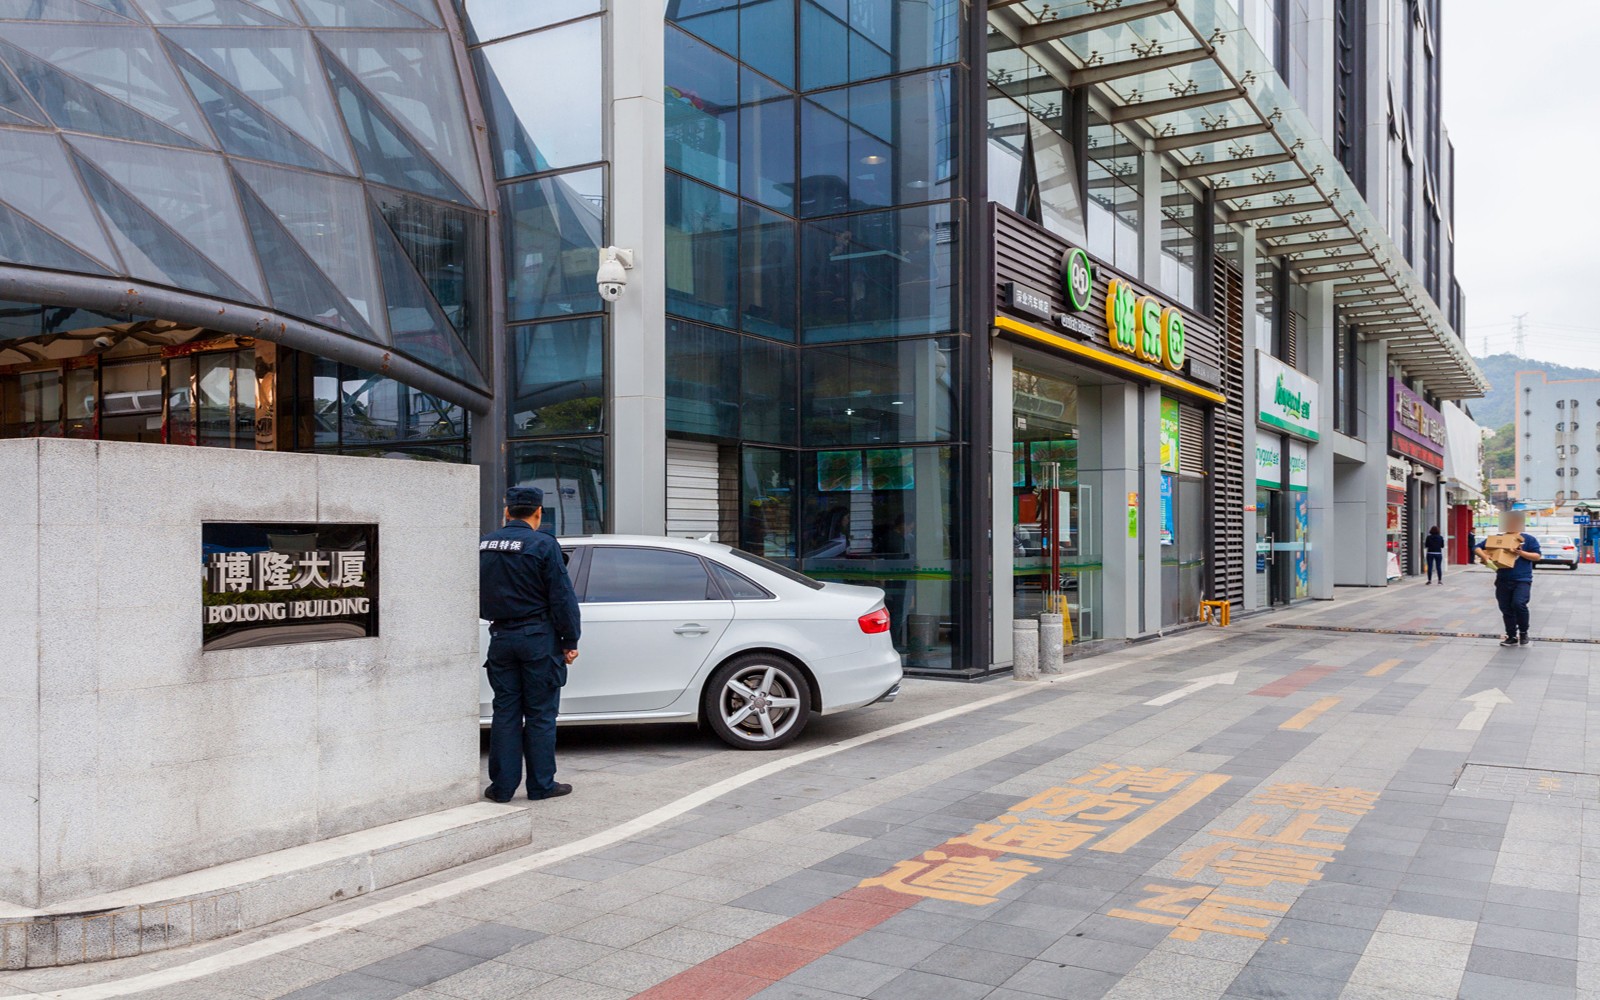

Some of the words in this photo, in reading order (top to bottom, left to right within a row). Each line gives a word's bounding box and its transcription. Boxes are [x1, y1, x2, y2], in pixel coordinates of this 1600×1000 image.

[207, 602, 287, 624] BOLONG
[292, 597, 370, 618] BUILDING
[211, 551, 366, 593] 博隆大厦
[858, 762, 1195, 906] 消防通道
[1106, 781, 1380, 942] 禁止停车
